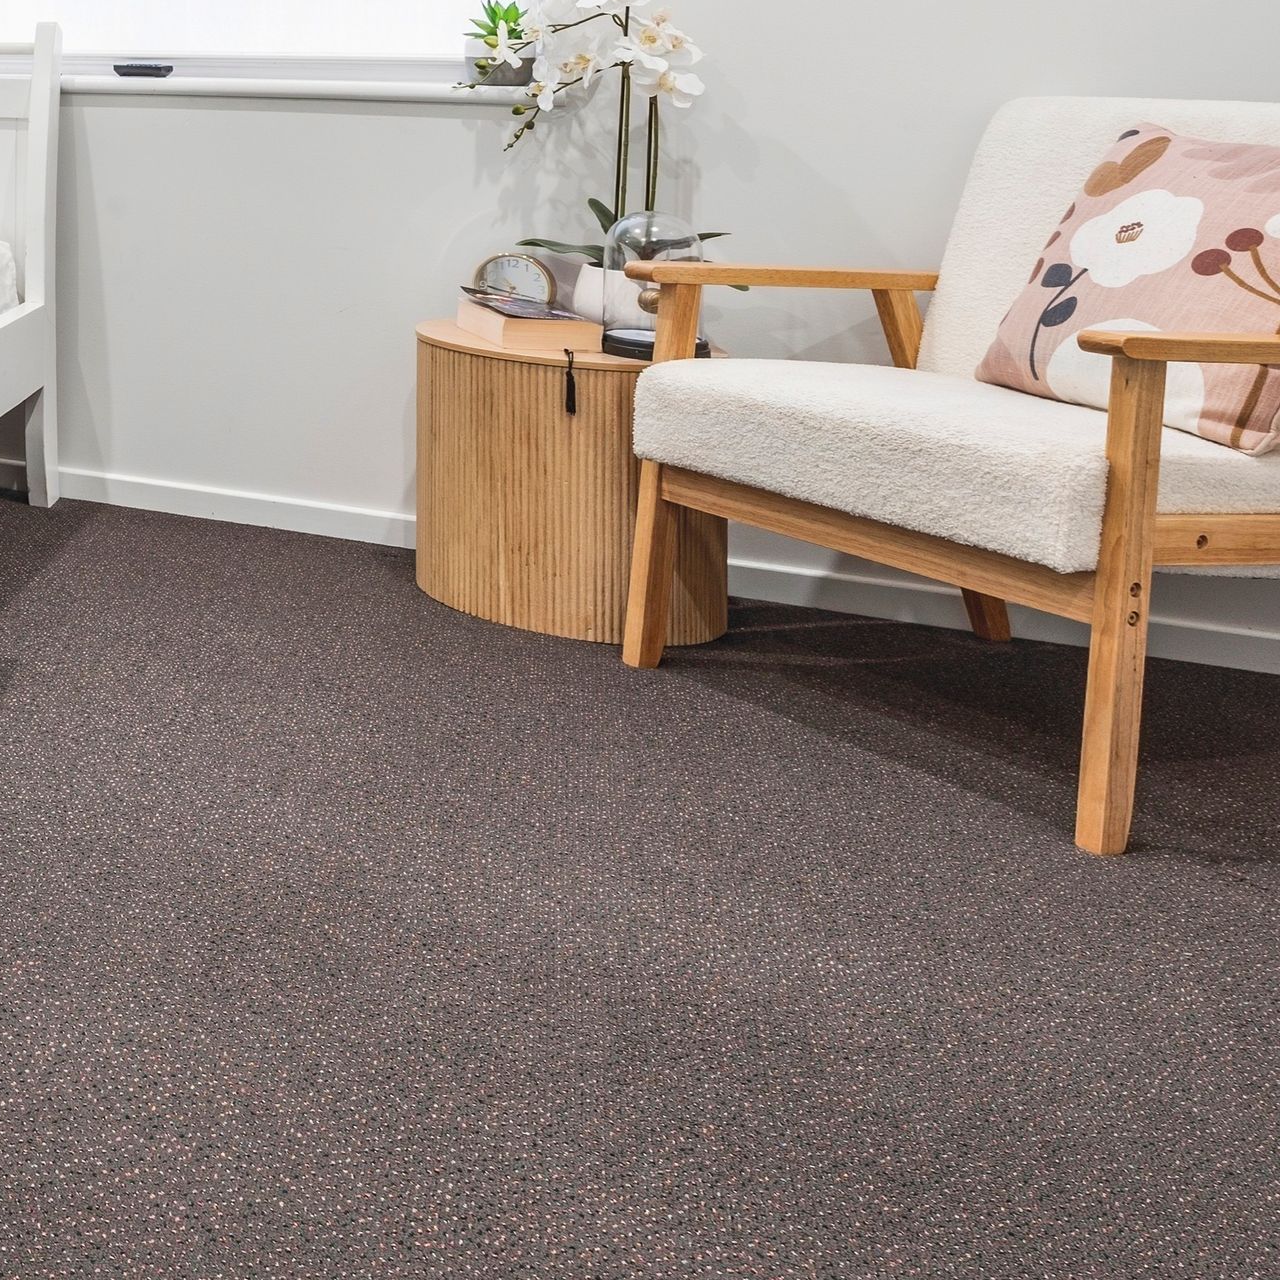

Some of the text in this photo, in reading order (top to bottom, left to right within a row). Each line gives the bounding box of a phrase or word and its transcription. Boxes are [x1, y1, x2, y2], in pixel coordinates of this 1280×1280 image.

[505, 259, 520, 269] 12
[525, 263, 529, 273] 1
[532, 272, 541, 282] 2
